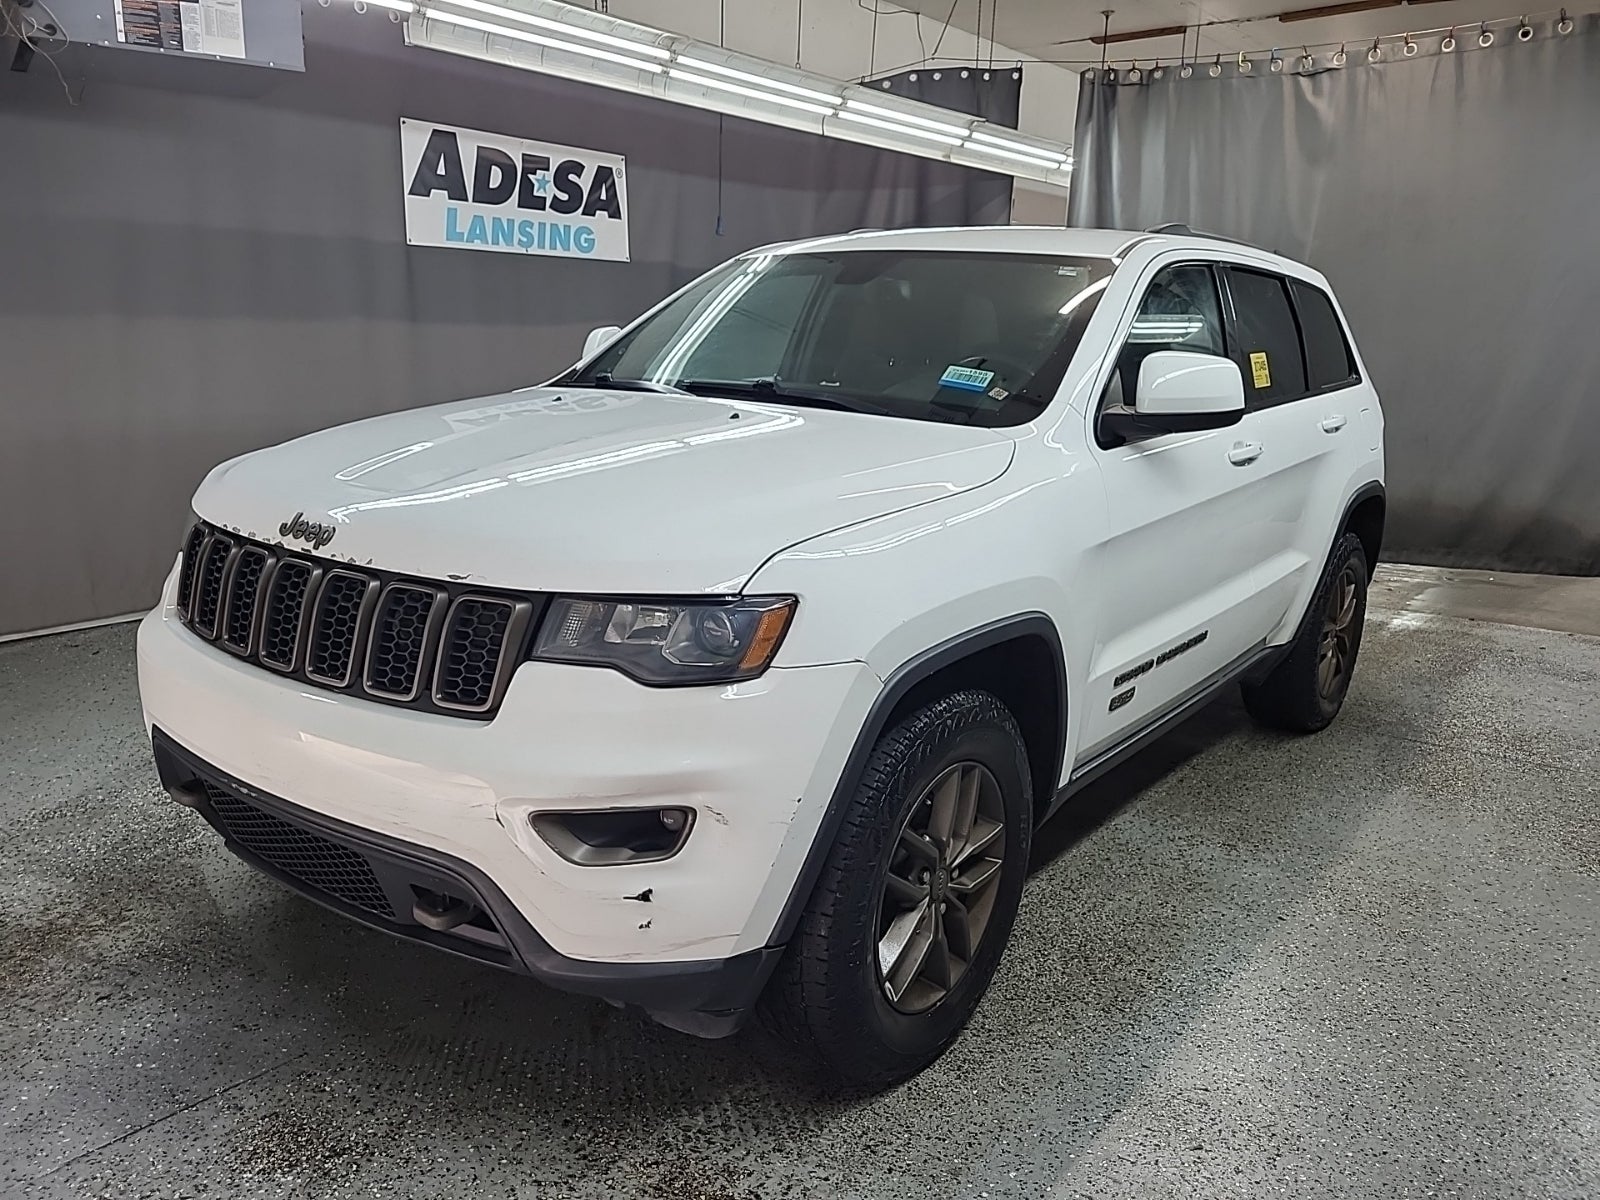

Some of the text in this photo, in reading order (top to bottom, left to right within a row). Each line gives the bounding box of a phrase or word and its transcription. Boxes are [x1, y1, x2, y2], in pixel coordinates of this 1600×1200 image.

[408, 129, 622, 221] ADESA
[445, 207, 597, 254] LANSING
[279, 511, 337, 551] Jeep
